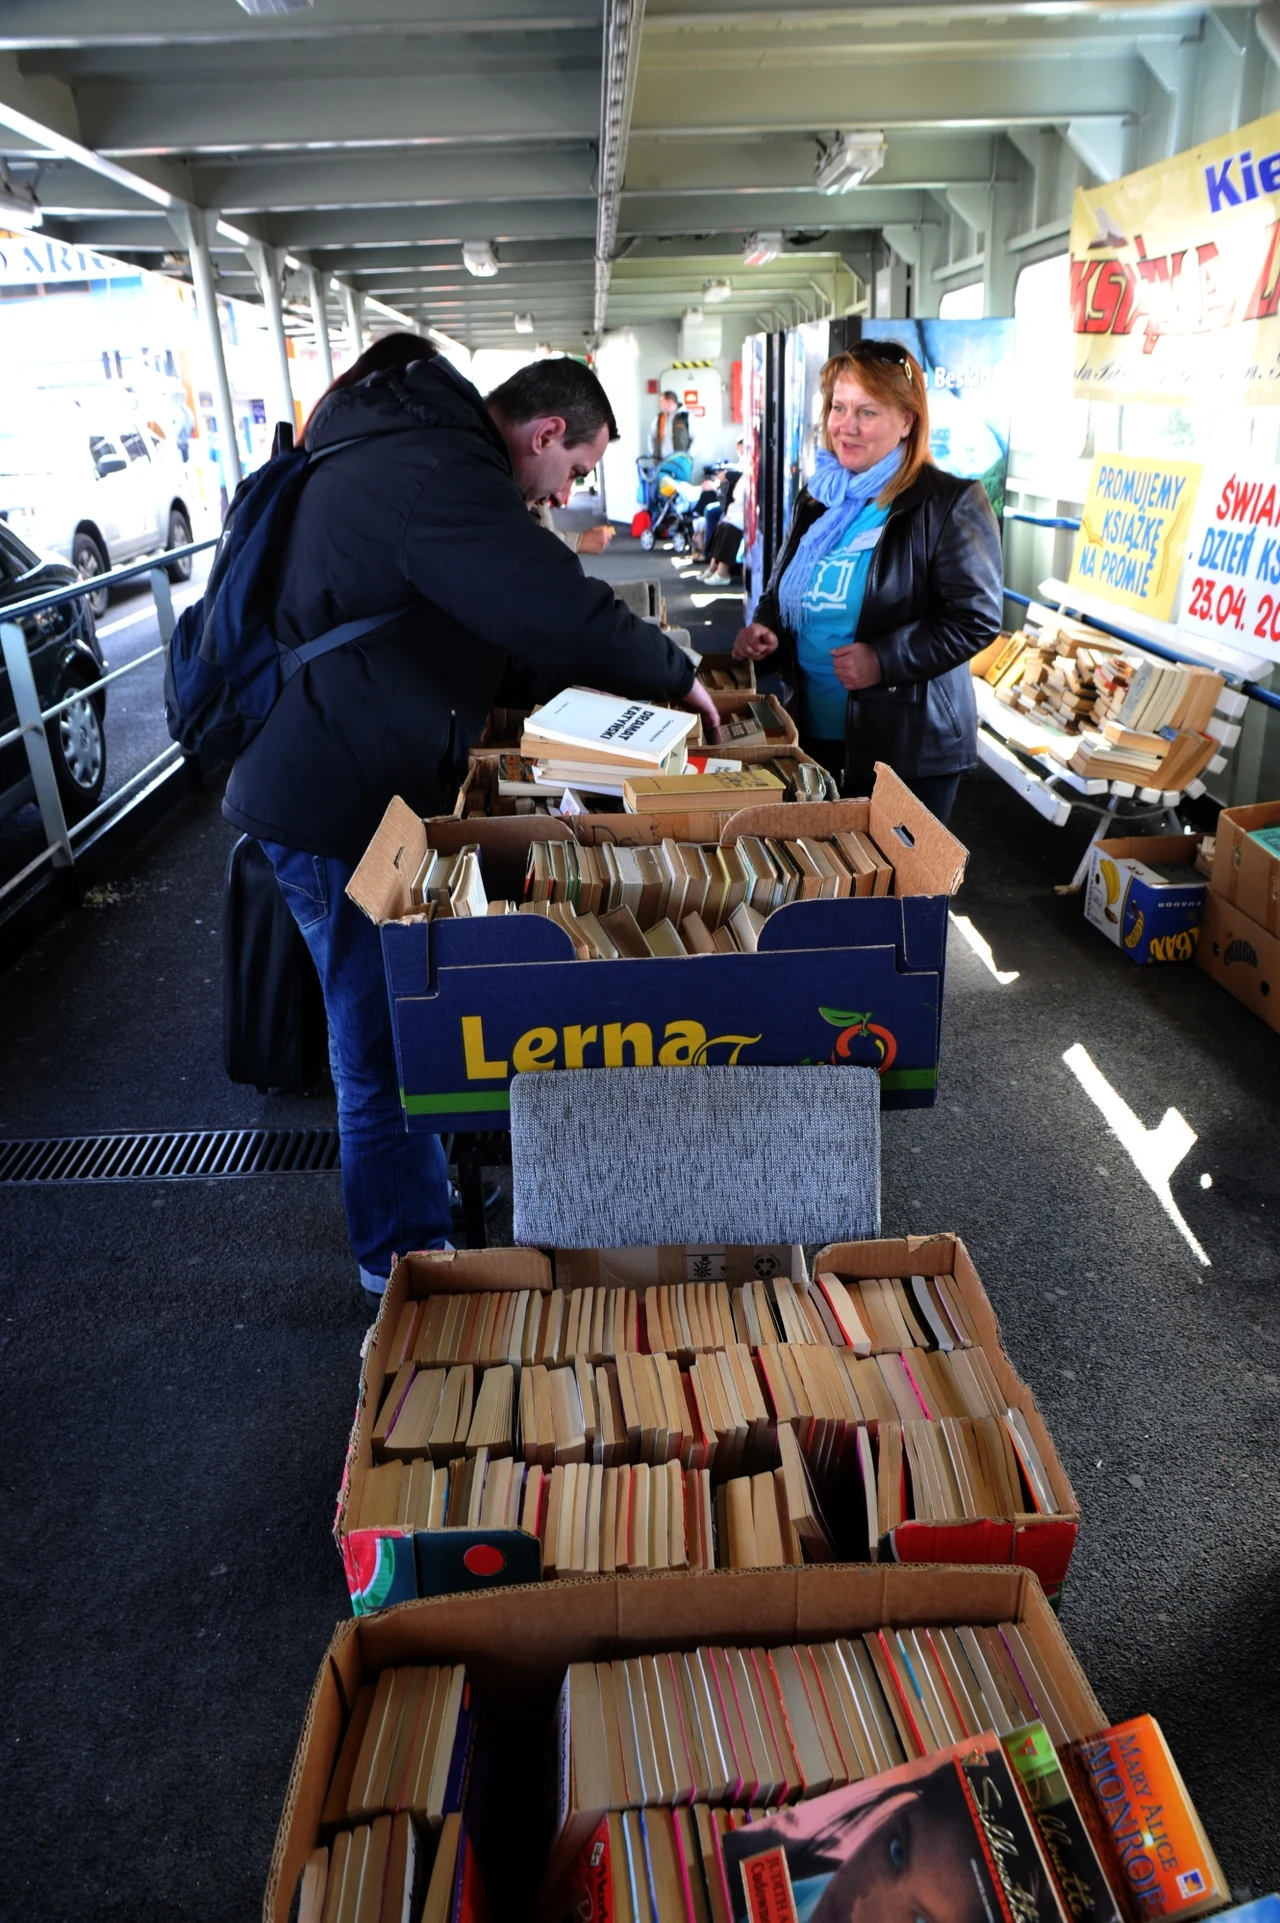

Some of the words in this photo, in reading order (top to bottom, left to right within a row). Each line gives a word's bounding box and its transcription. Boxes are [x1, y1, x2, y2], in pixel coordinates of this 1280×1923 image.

[1096, 466, 1186, 513] PROMUJEMY
[1216, 473, 1280, 528] ŚWIA
[1100, 505, 1164, 562] KSIĄŻKĘ
[1198, 525, 1257, 577] DZIEŃ
[1079, 545, 1097, 578] NA
[1099, 550, 1154, 598] PROMIE
[1188, 577, 1246, 631] 23.04.
[599, 705, 642, 740] KATYŃSKI
[618, 710, 656, 741] DRAMAT
[461, 1015, 707, 1080] Lerna
[1117, 1733, 1153, 1801] MARY
[1141, 1802, 1179, 1872] ALICE
